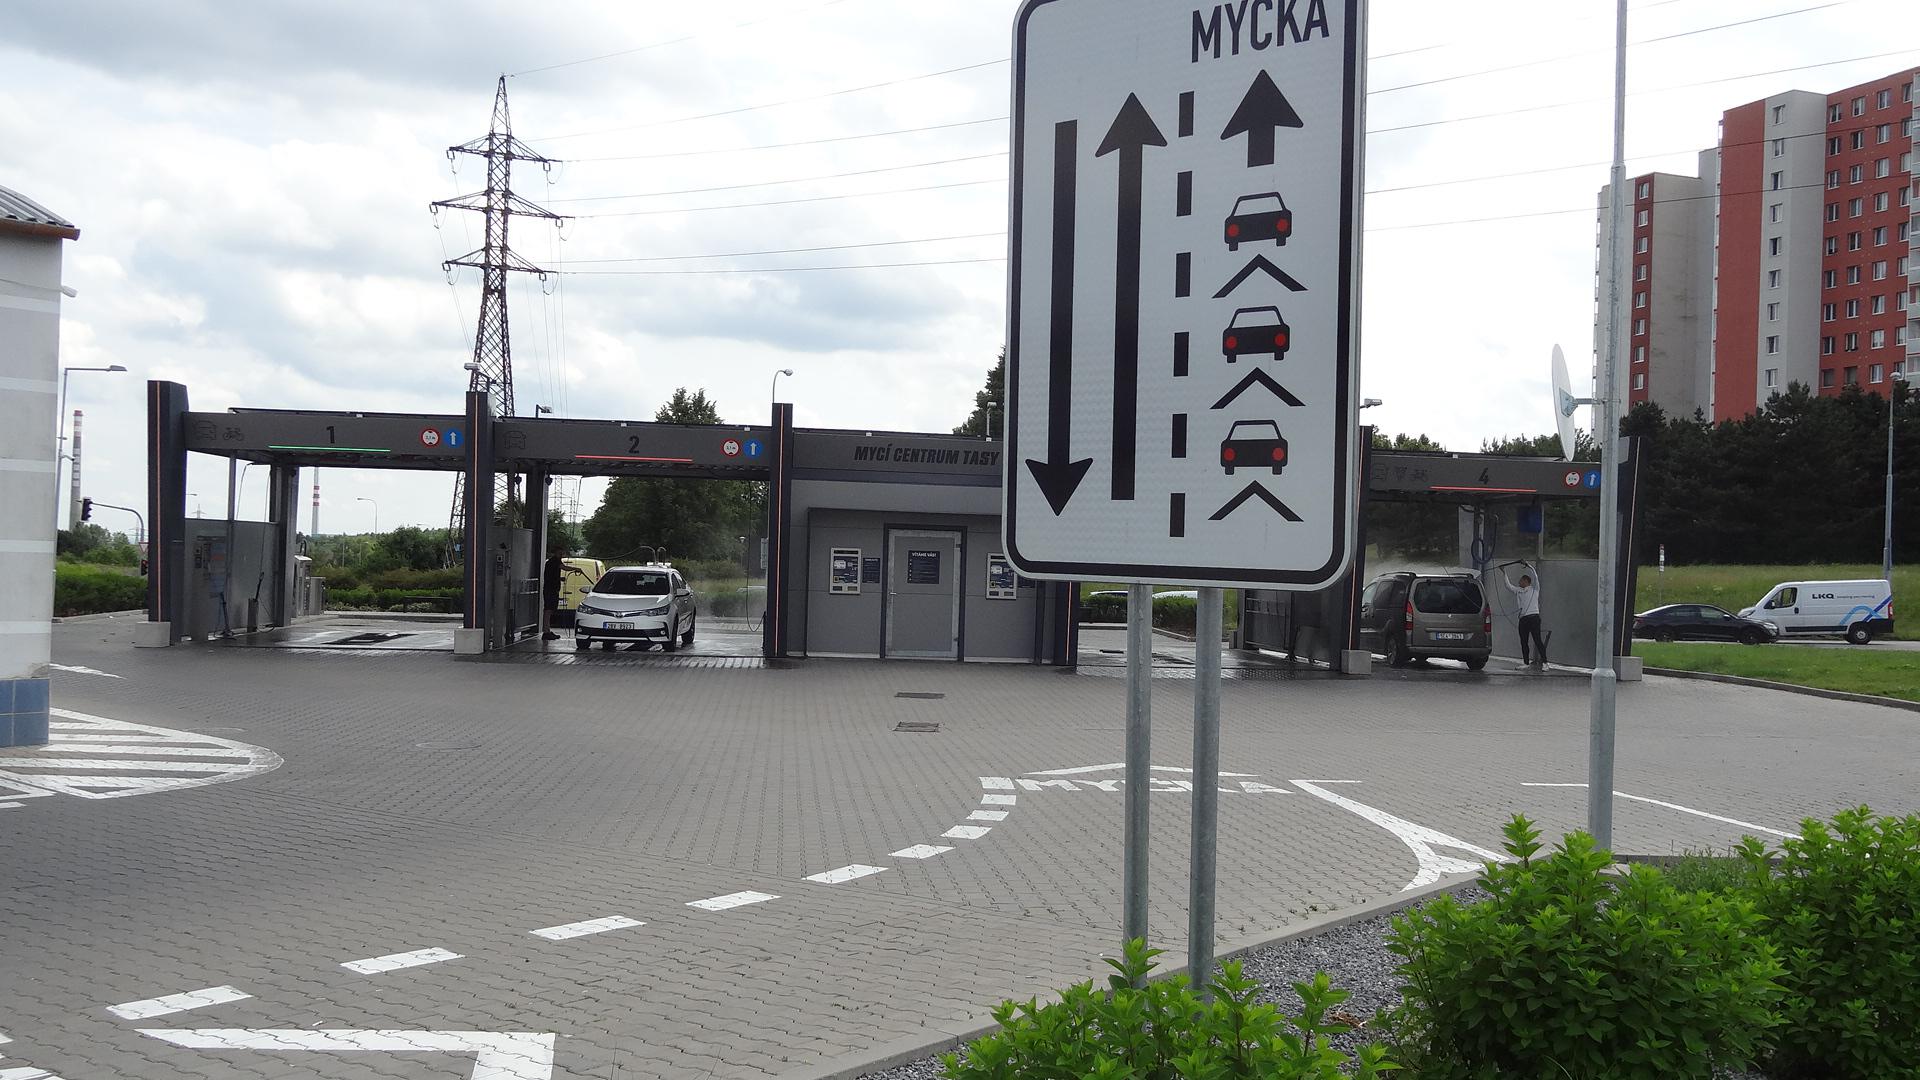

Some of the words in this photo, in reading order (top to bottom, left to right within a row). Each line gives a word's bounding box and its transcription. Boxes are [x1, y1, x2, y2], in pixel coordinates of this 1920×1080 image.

[326, 425, 335, 444] 1
[628, 435, 640, 454] 2
[854, 443, 893, 461] MYCÍ
[893, 447, 959, 464] CENTRUM
[962, 450, 1000, 466] TASY
[1478, 467, 1489, 485] 4
